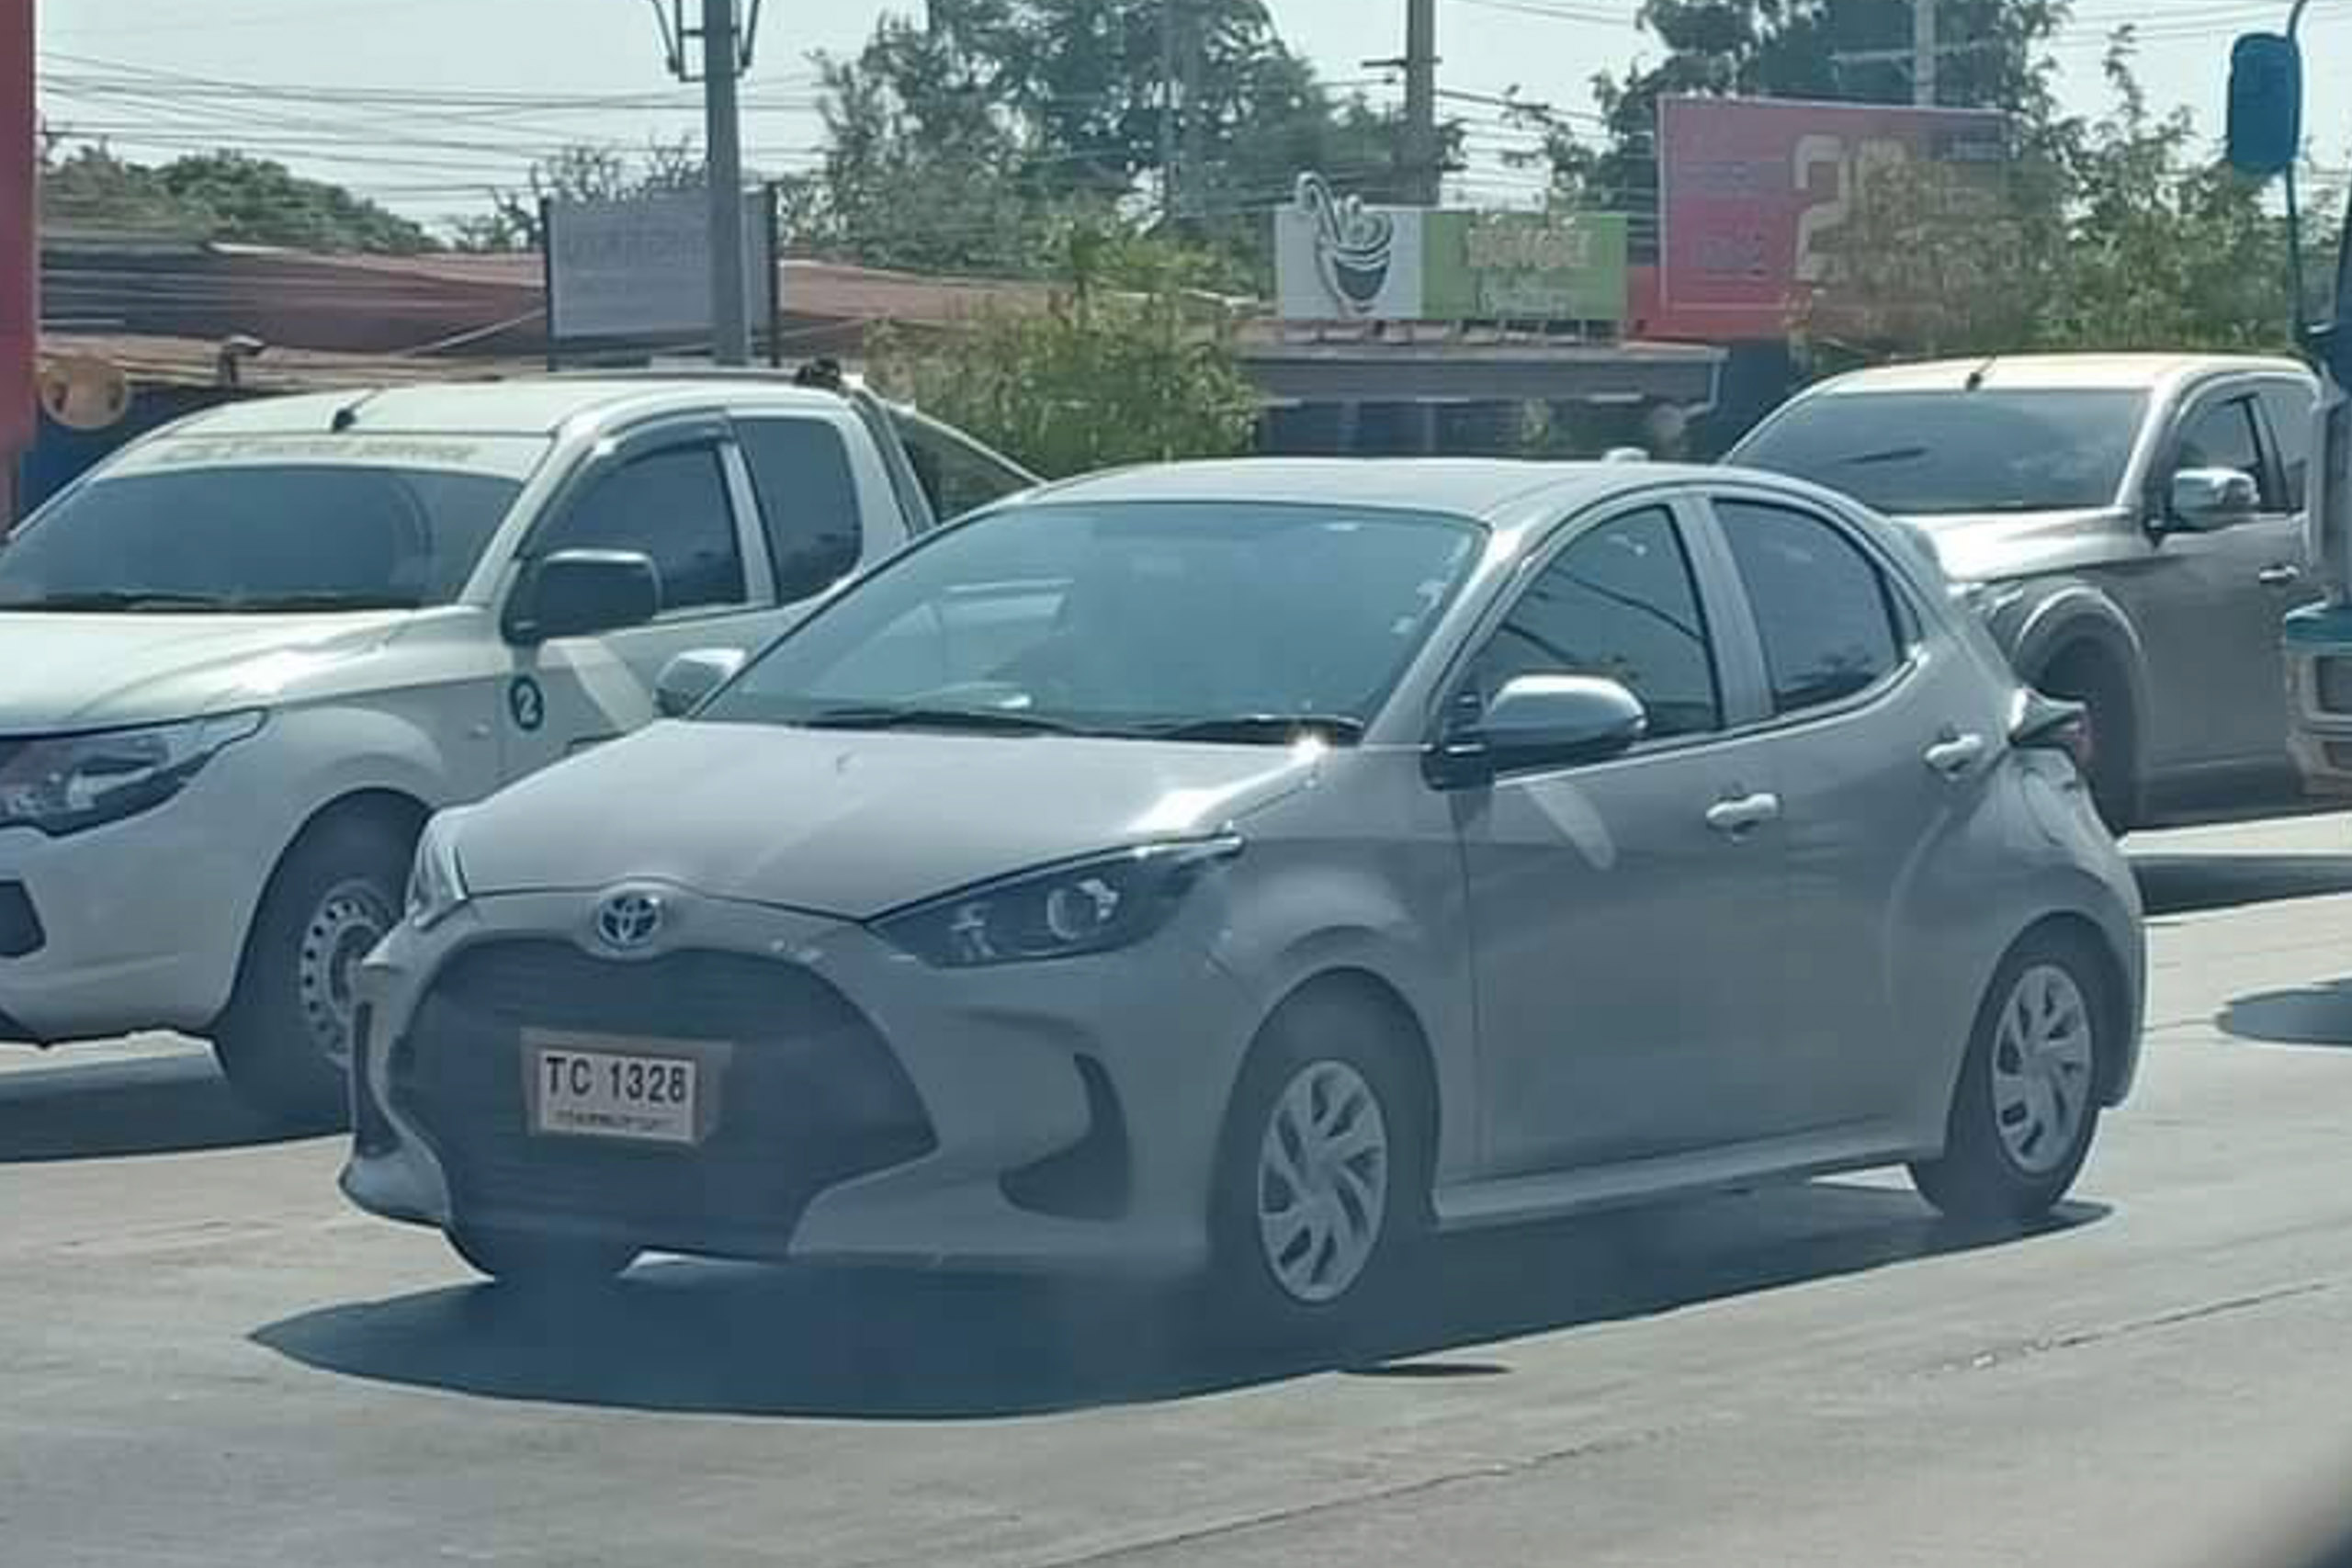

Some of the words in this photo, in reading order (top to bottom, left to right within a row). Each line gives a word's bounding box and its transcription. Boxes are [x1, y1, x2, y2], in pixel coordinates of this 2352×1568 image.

[515, 684, 538, 723] 2
[546, 1056, 592, 1096] TC
[610, 1061, 686, 1102] 1328
